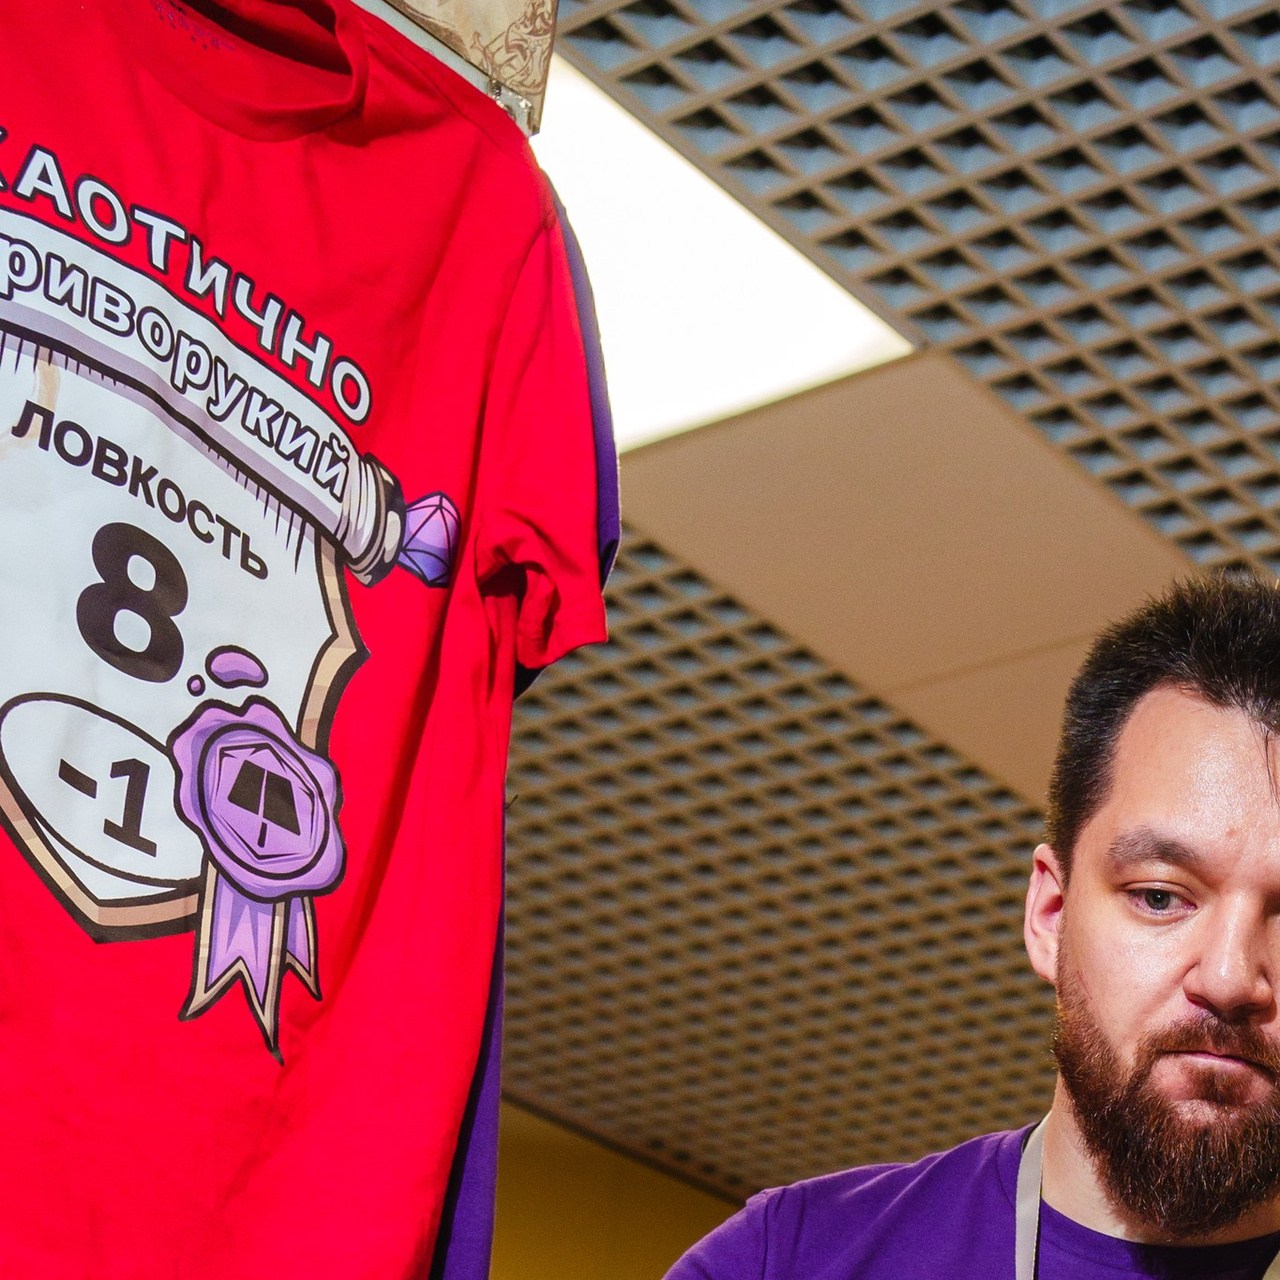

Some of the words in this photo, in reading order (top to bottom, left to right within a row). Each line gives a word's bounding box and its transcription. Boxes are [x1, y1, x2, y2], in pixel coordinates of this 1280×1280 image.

[0, 126, 372, 425] АОТИЧНО
[10, 400, 269, 581] ЛОВКОСТЬ
[76, 521, 189, 683] 8
[58, 757, 158, 858] -1
